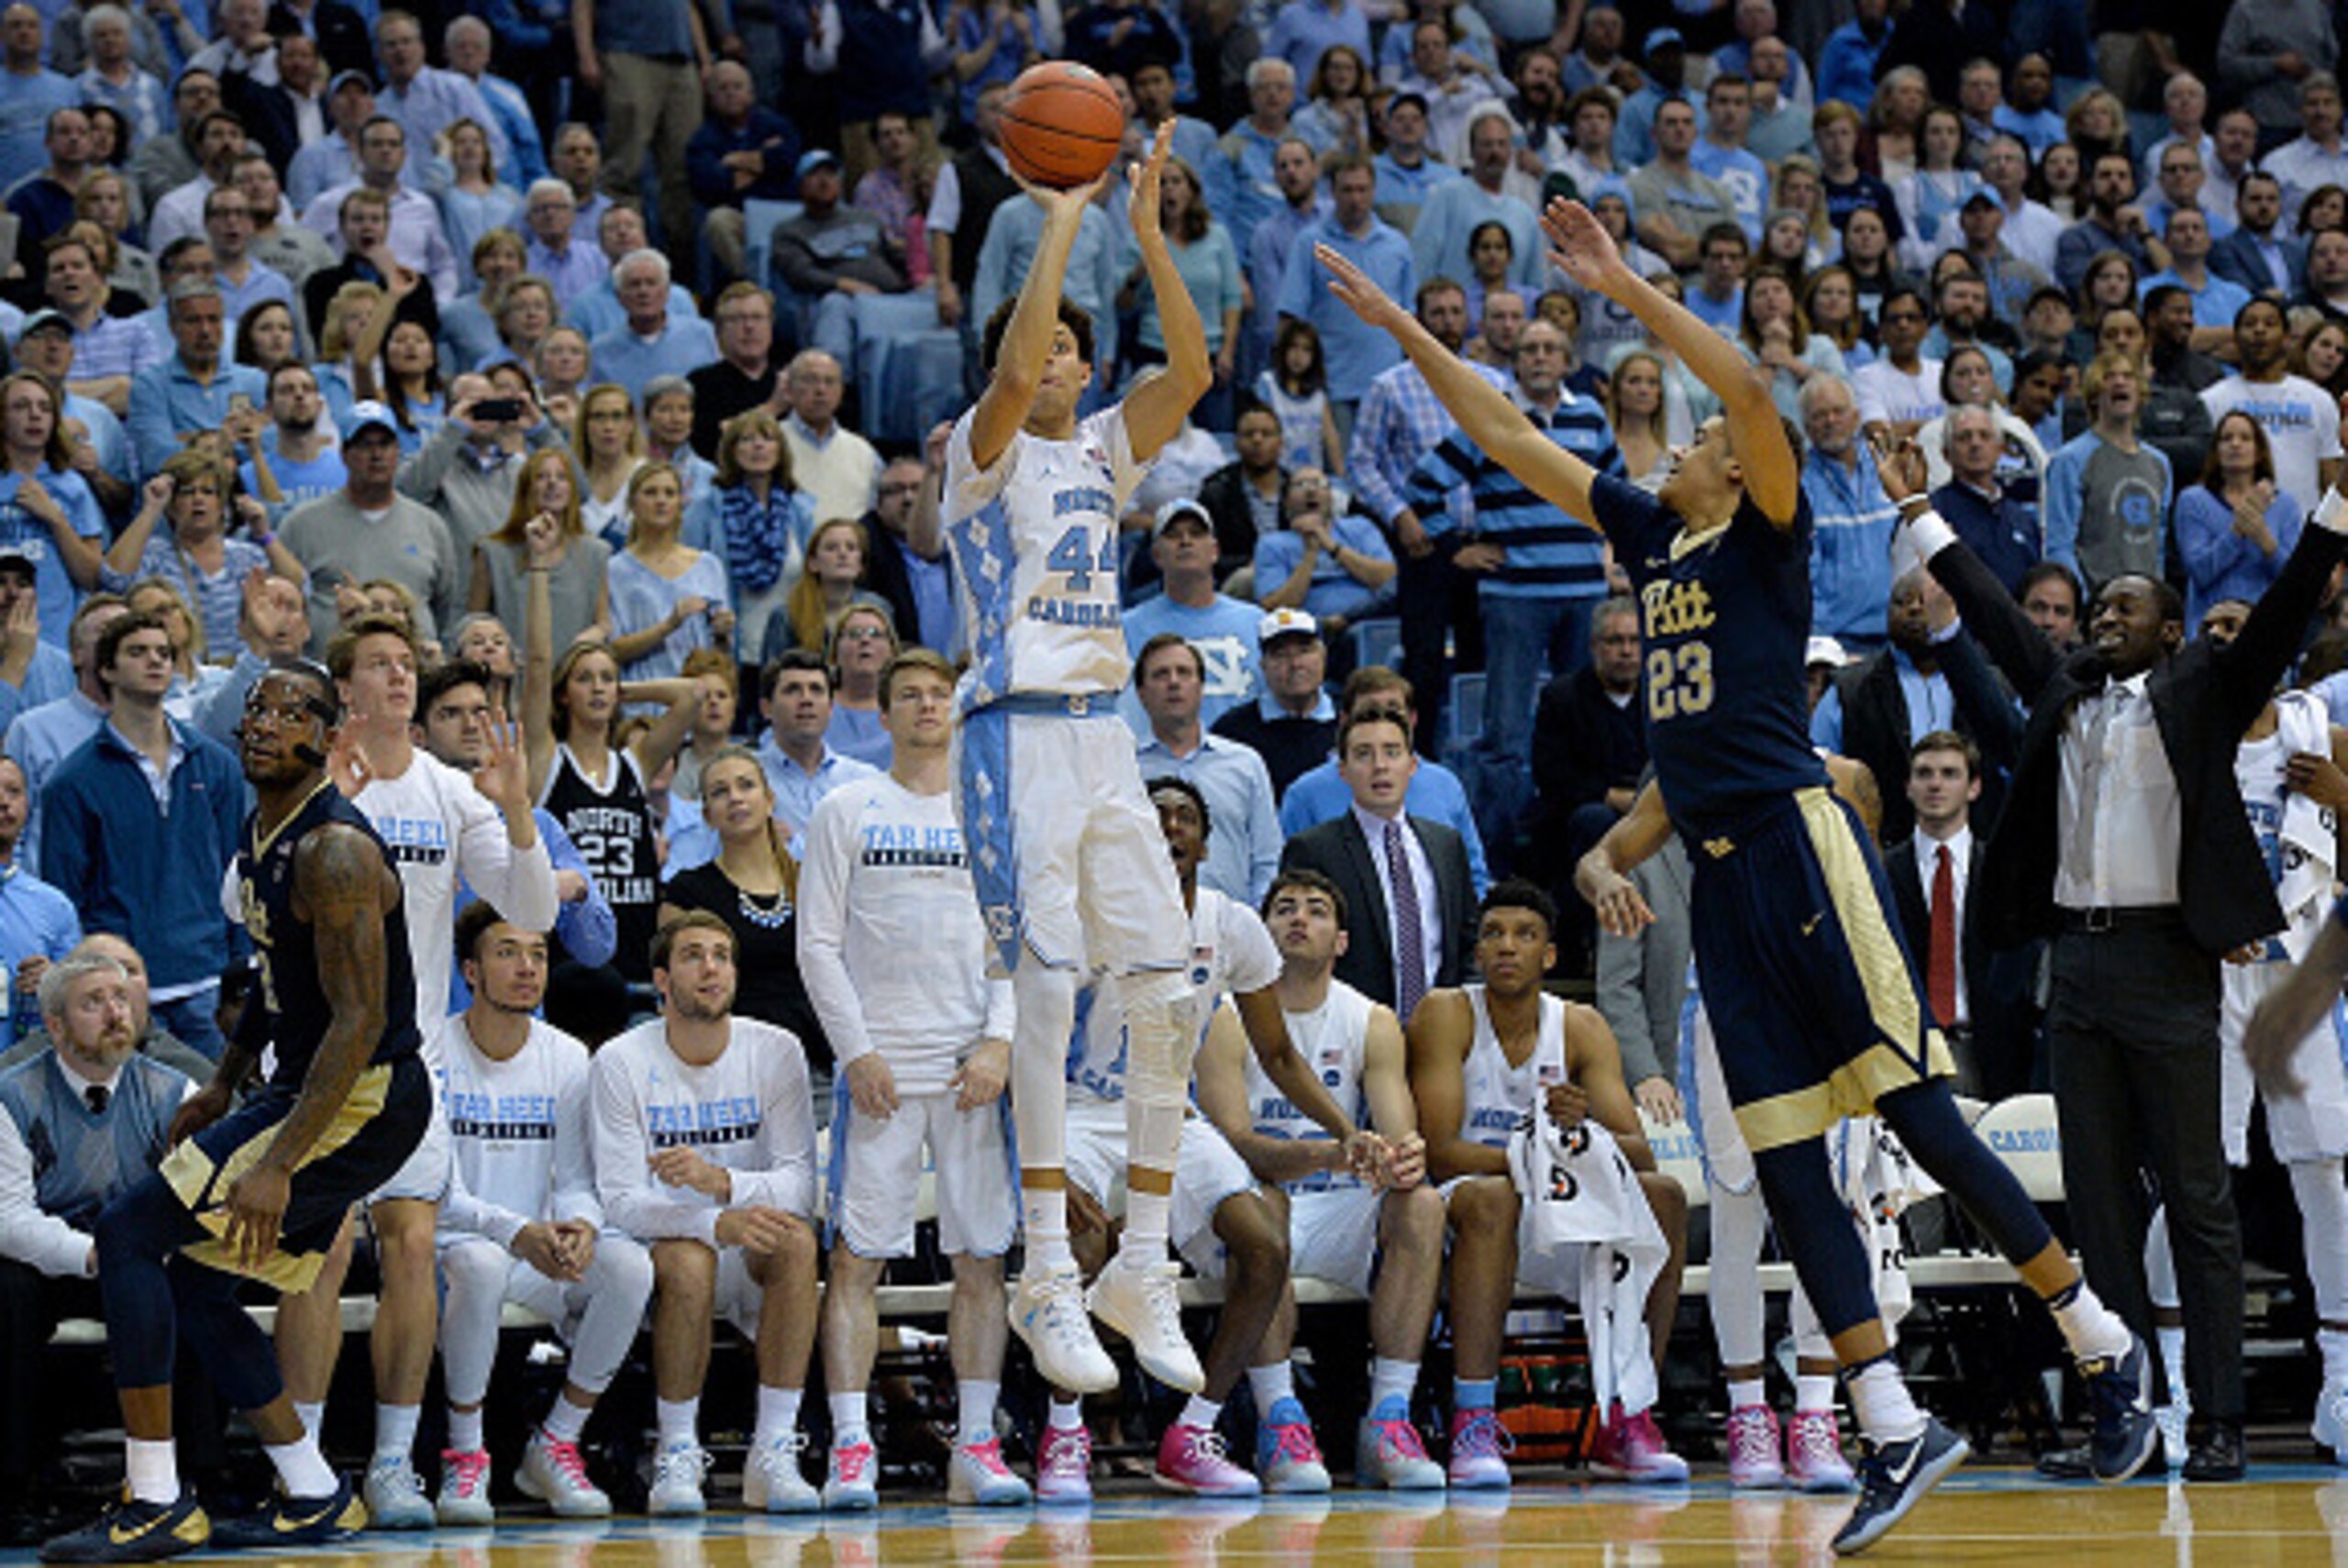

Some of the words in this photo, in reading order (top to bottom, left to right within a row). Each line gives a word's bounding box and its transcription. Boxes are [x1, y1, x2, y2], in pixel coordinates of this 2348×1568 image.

[1641, 580, 1716, 637] Pitt
[1647, 641, 1714, 721] 23
[567, 808, 642, 838] NORTH
[864, 824, 917, 850] TAR
[578, 834, 635, 875] 23
[453, 1093, 492, 1120] TAR
[498, 1095, 556, 1122] HEEL
[646, 1104, 692, 1132] TAR
[697, 1095, 760, 1130] HEEL
